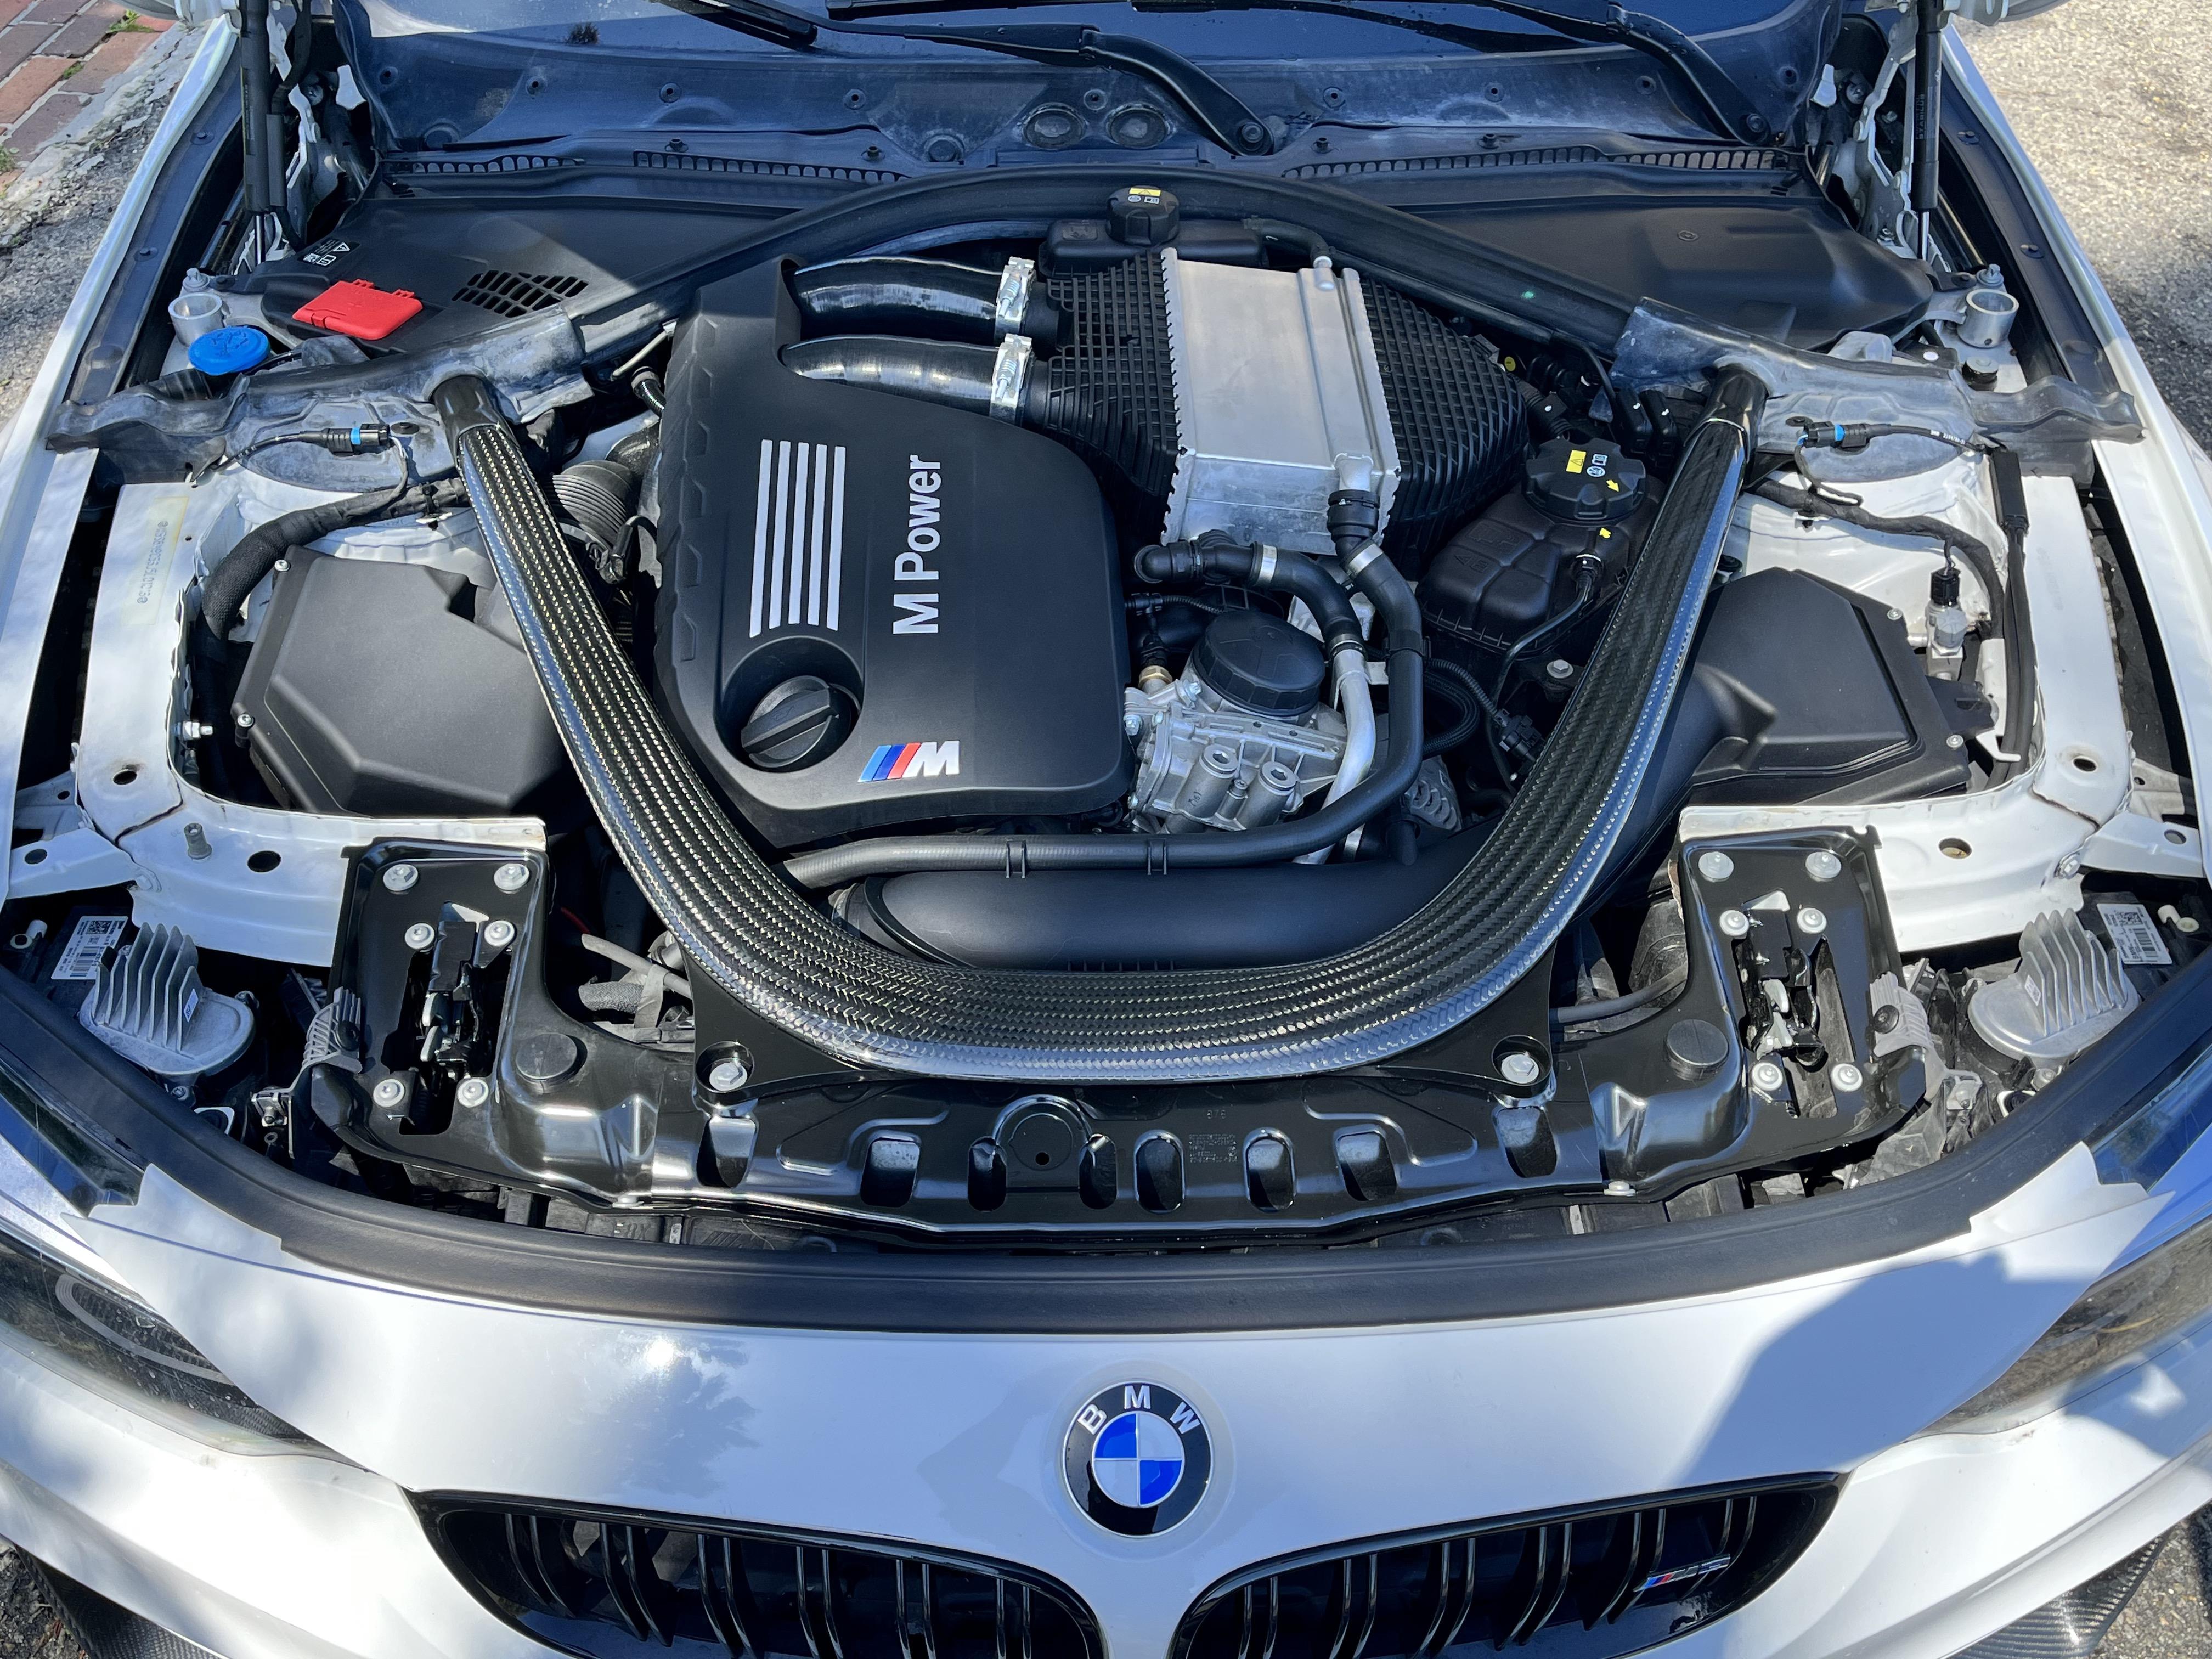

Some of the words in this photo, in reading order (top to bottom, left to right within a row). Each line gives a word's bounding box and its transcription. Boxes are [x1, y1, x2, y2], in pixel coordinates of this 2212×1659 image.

[894, 454, 942, 581] Power
[893, 592, 939, 634] M
[901, 740, 960, 778] M
[1078, 1385, 1200, 1435] BMW
